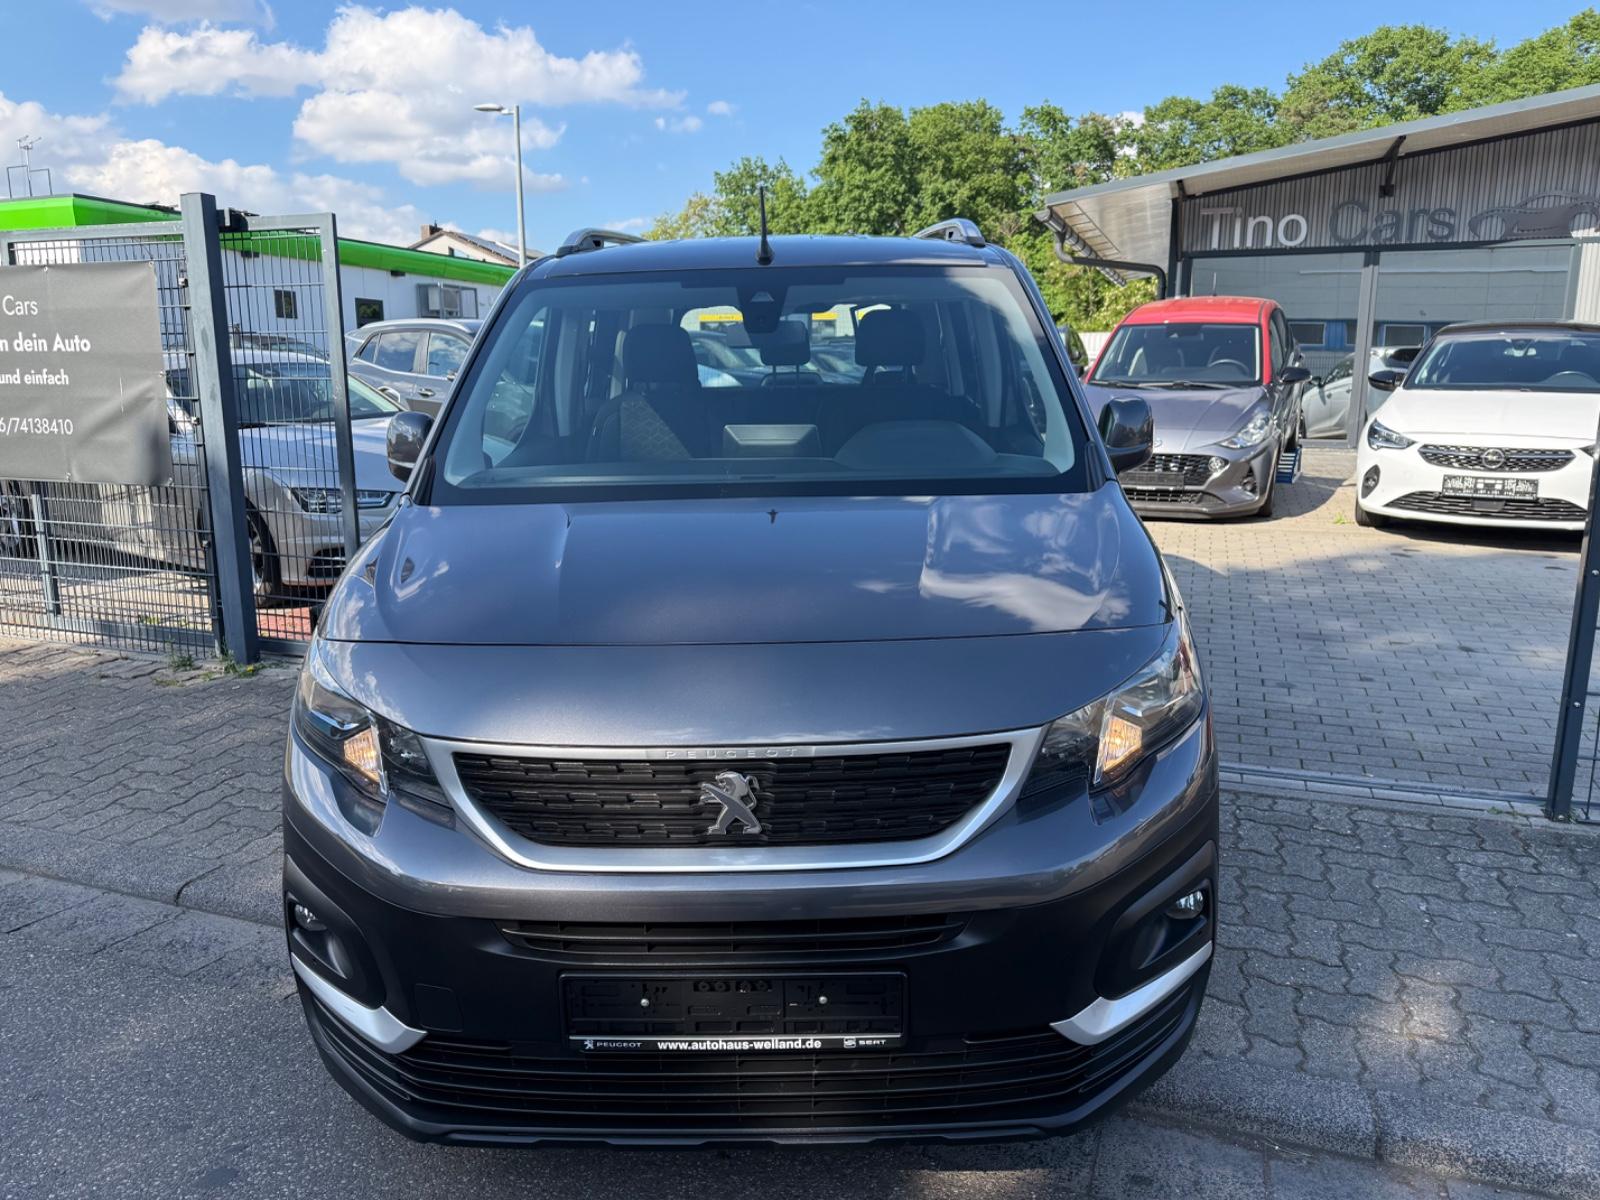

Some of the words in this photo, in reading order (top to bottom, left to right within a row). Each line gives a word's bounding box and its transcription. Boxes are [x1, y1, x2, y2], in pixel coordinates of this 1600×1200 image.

[1200, 206, 1308, 250] Tino
[1329, 200, 1457, 244] Cars
[2, 294, 39, 316] Cars
[13, 331, 48, 352] dein
[53, 332, 91, 352] Auto
[0, 368, 21, 385] und
[24, 368, 69, 385] einfach
[665, 748, 798, 759] PEUGEOT
